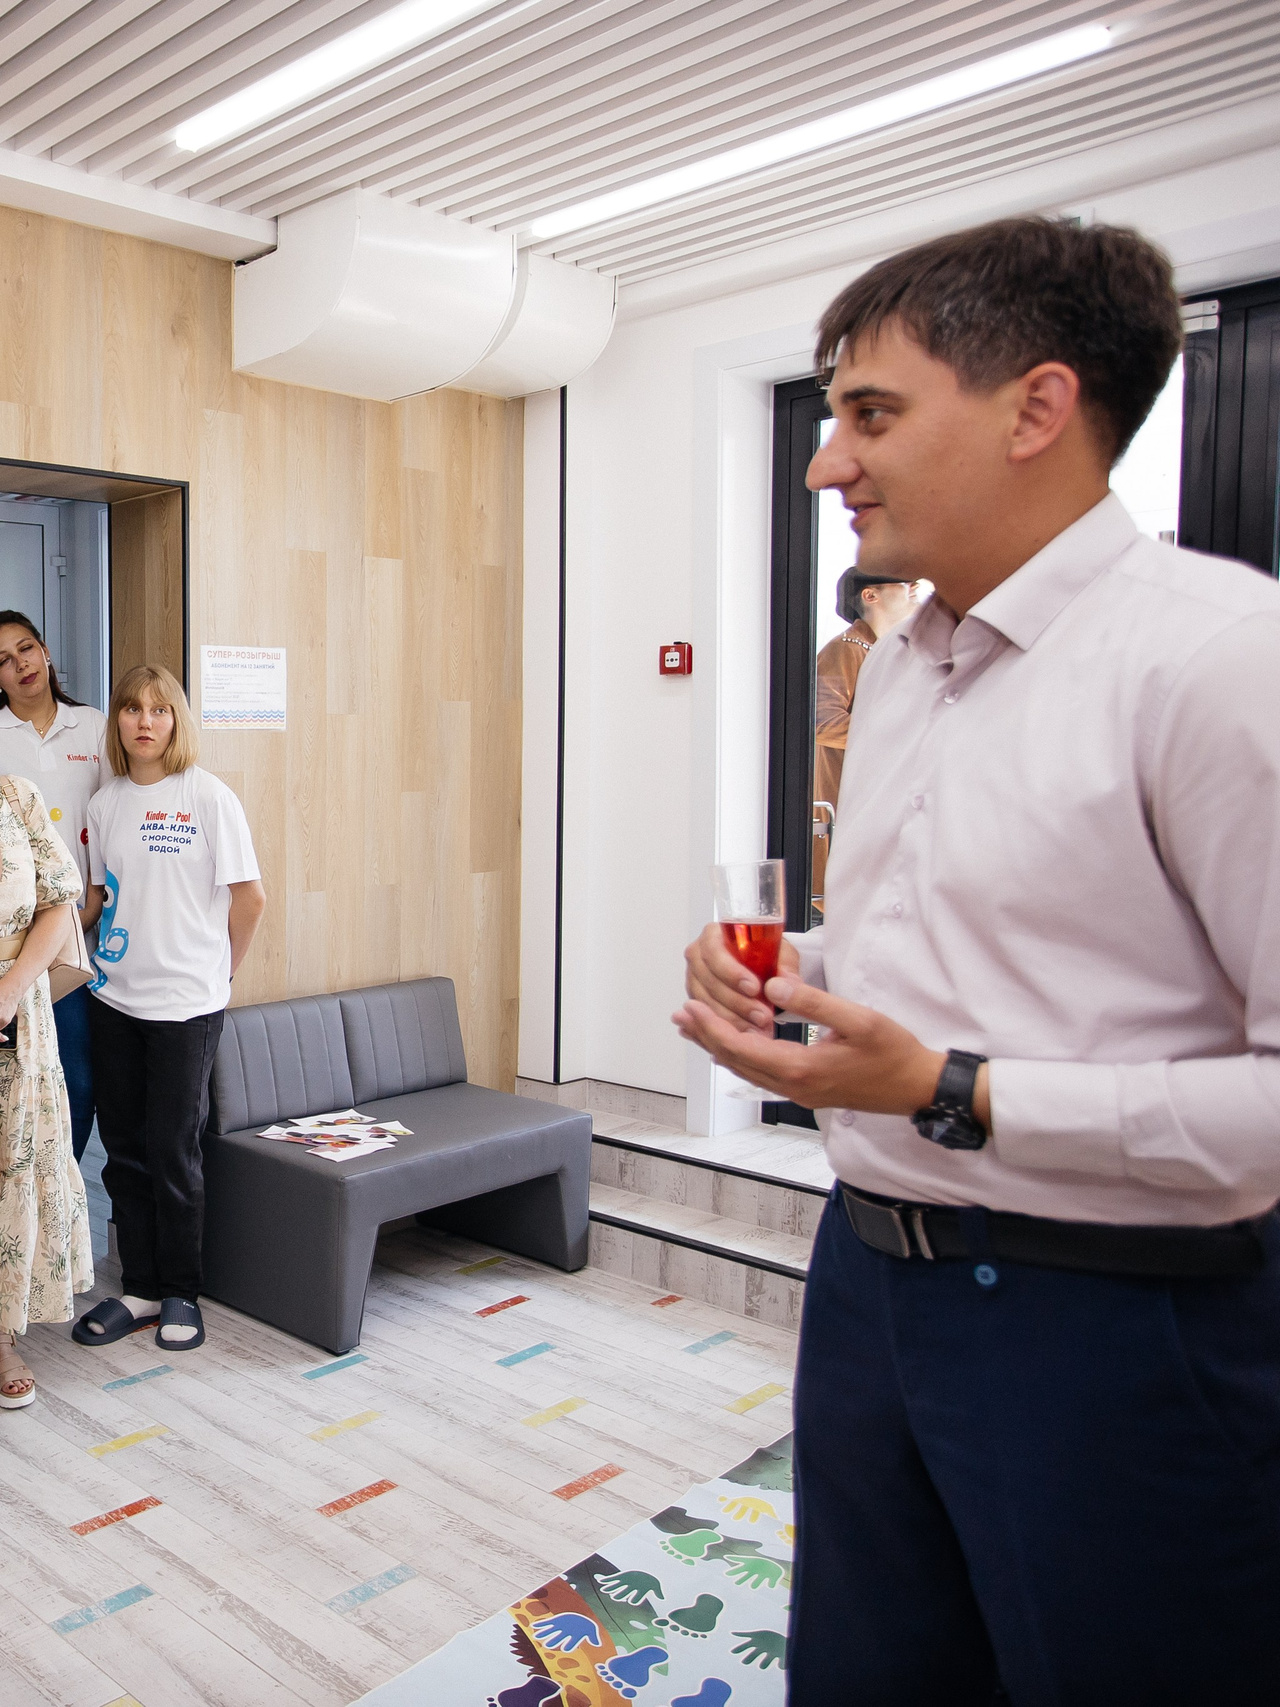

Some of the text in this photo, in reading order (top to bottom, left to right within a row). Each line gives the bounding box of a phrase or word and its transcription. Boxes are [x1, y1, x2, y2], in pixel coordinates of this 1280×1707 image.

[207, 650, 281, 660] СУПЕР-РОЗЫГРЫШ
[93, 754, 99, 763] P
[145, 810, 191, 823] Kinder Pool
[139, 823, 197, 835] АКВА-КЛУБ
[148, 835, 192, 845] МОРСКОЙ
[149, 845, 180, 854] ВОДОЙ
